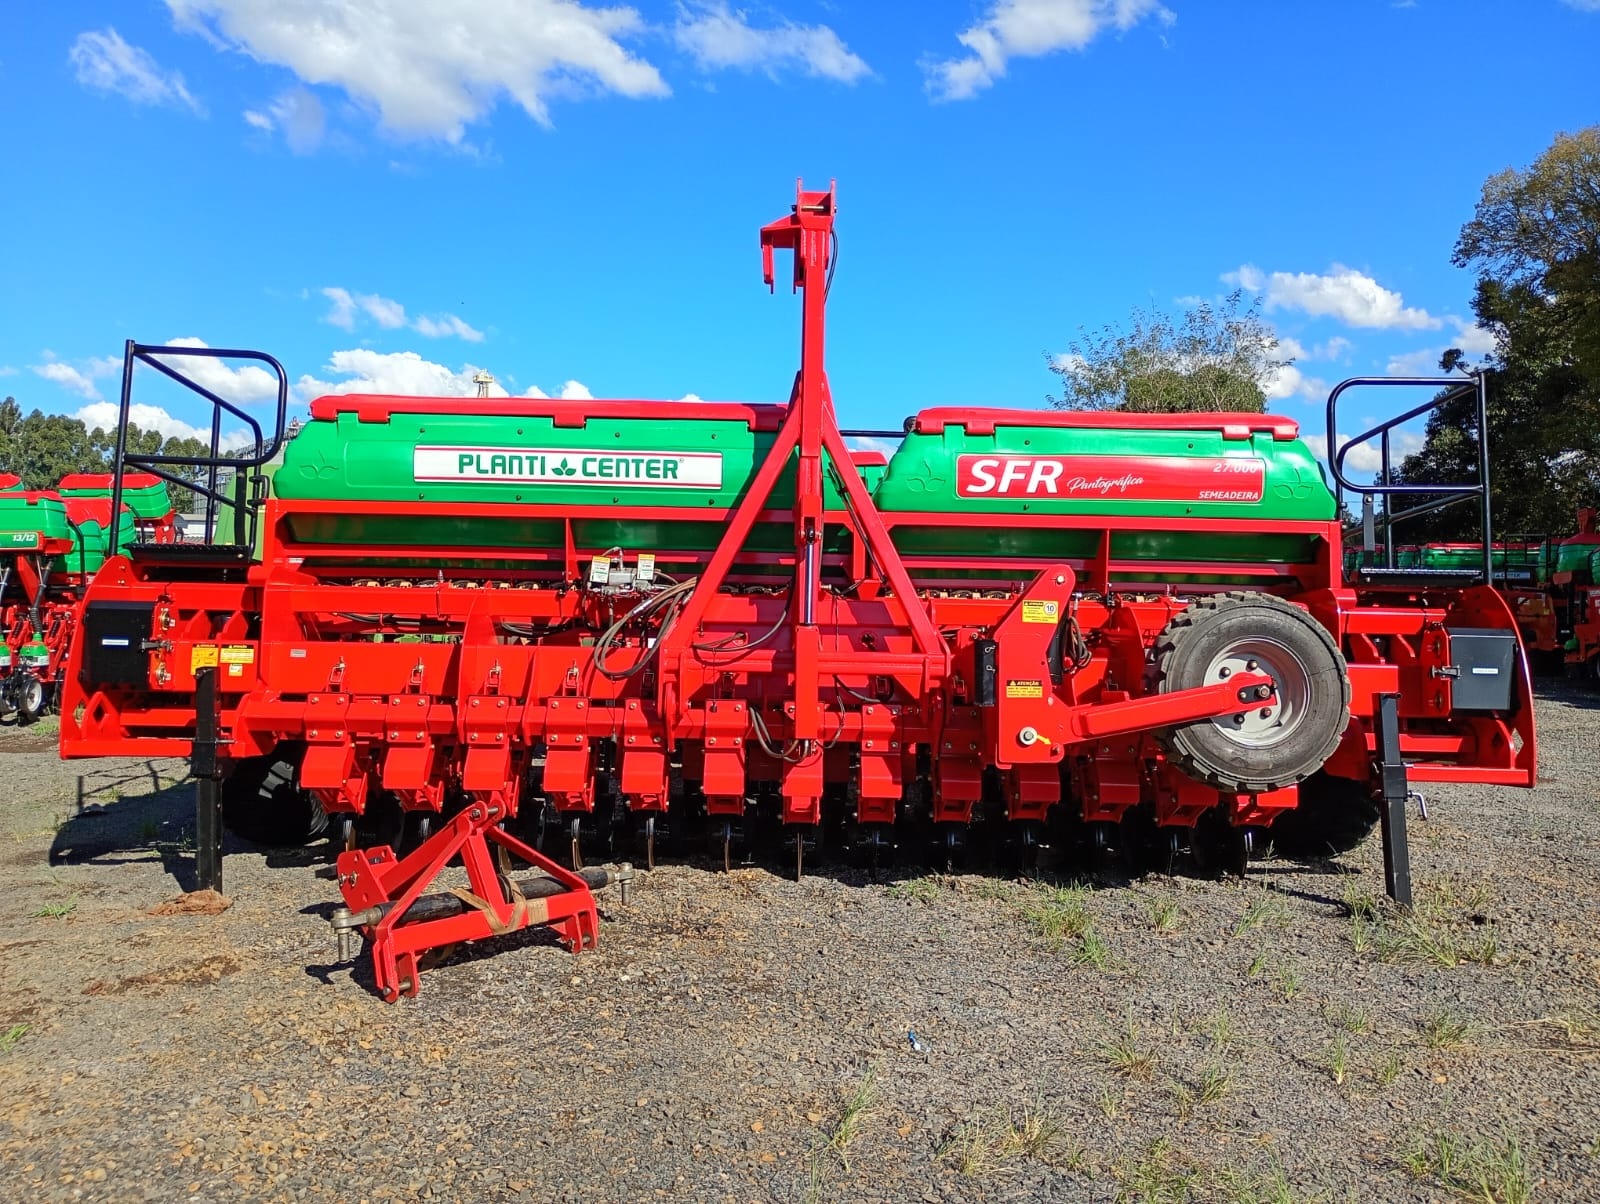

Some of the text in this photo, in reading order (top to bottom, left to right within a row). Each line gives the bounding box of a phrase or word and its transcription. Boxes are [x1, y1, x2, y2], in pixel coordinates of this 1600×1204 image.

[458, 454, 678, 479] PLANTI CENTER
[1213, 463, 1257, 474] 27.000
[966, 459, 1144, 494] SFR Pantográfica
[1198, 490, 1259, 500] SEMEADEIRA
[13, 534, 35, 542] 13/12
[1046, 604, 1055, 612] 10
